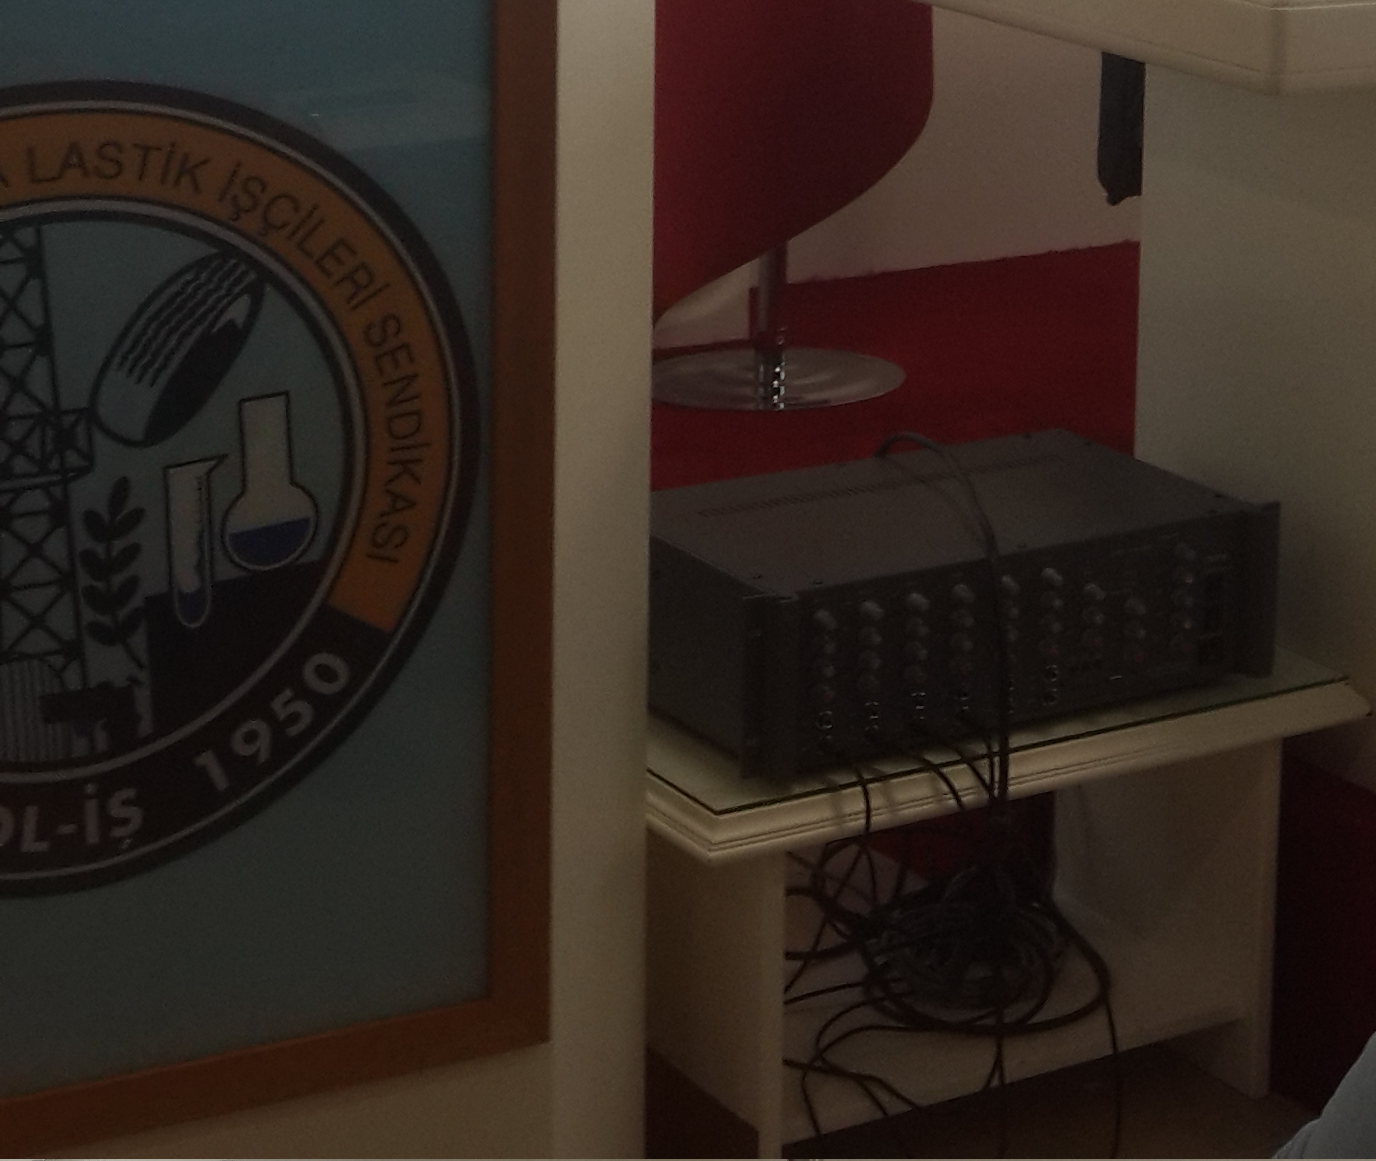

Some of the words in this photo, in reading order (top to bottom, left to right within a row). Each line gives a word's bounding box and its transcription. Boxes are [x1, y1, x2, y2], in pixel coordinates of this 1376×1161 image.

[25, 142, 210, 193] LASTİK
[217, 161, 391, 312] İŞÇİLERİ
[363, 312, 432, 564] SENDİKASI
[194, 651, 353, 792] 1950
